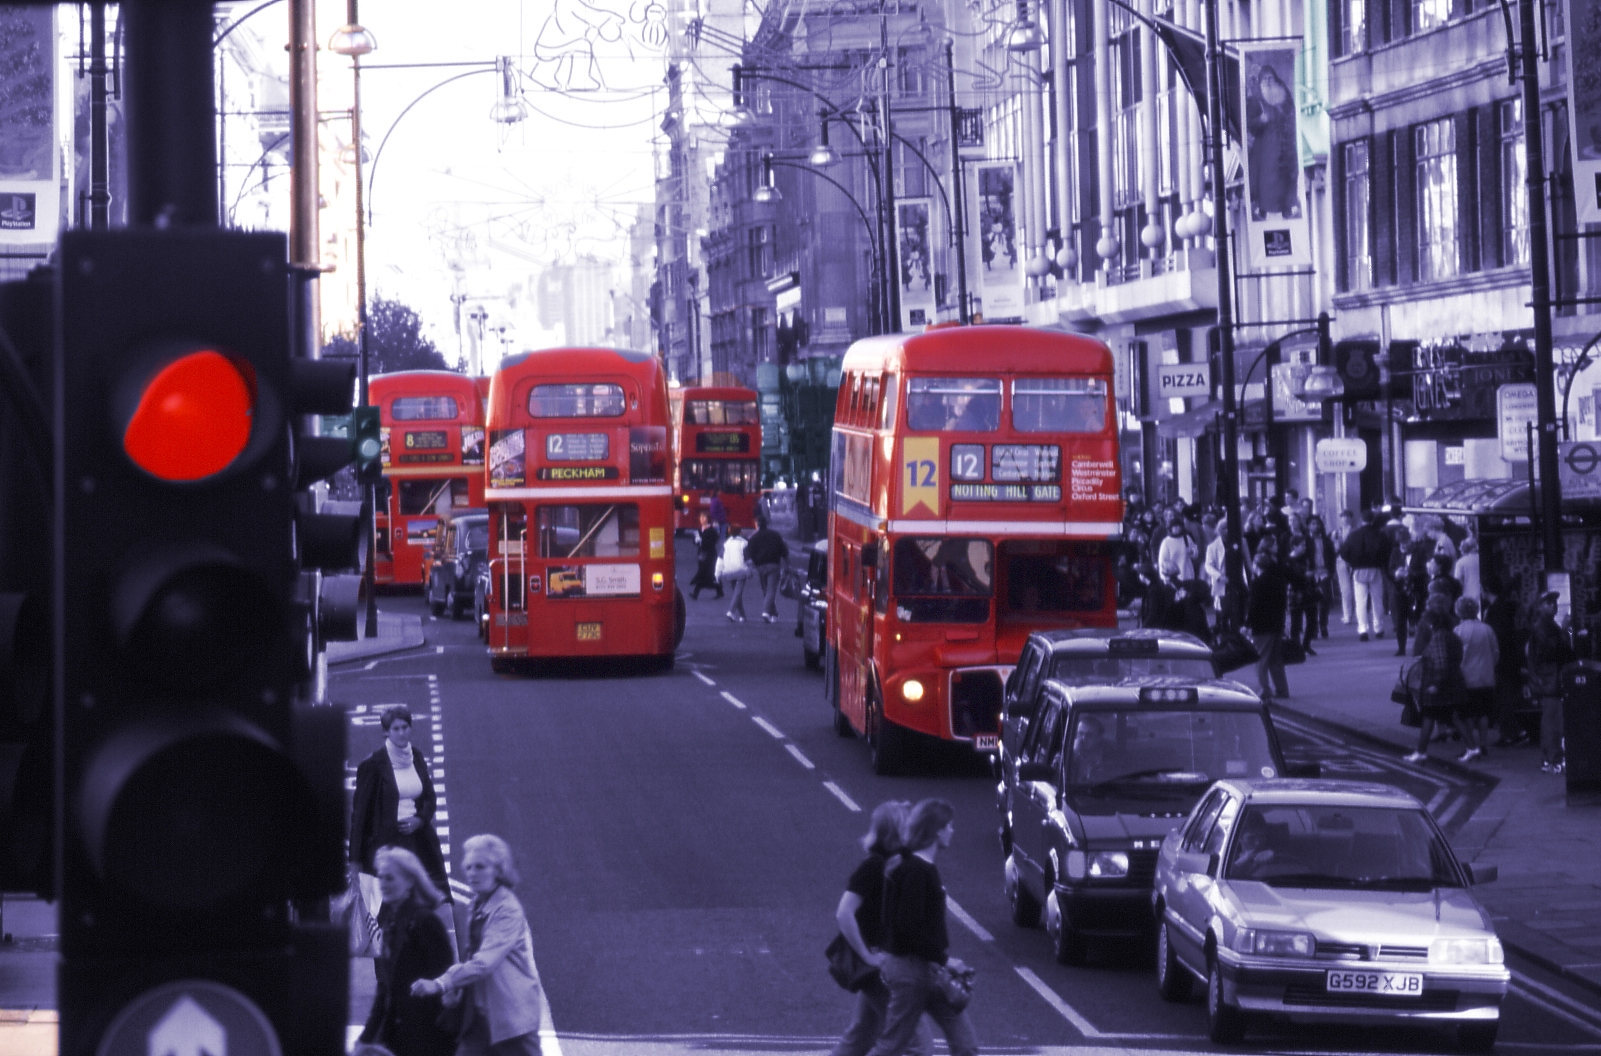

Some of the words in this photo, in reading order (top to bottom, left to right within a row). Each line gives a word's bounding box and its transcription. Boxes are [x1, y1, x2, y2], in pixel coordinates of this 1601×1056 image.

[1162, 373, 1206, 388] PIZZA
[1504, 391, 1535, 399] OMEGA
[406, 433, 415, 448] 8
[548, 434, 563, 454] 12
[1323, 449, 1358, 457] COFFEE
[956, 453, 979, 478] 12
[1071, 460, 1114, 468] Camberwell
[551, 468, 606, 479] PECKHAM
[906, 459, 937, 488] 12
[1071, 469, 1116, 477] Westminster
[954, 484, 998, 498] NOTTING
[1006, 485, 1028, 498] HILL
[1034, 485, 1059, 499] GATE
[1071, 484, 1093, 492] Circus
[1071, 492, 1097, 501] Oxford
[1098, 492, 1121, 501] Street
[1328, 972, 1379, 990] G592
[1383, 976, 1420, 992] XJB
